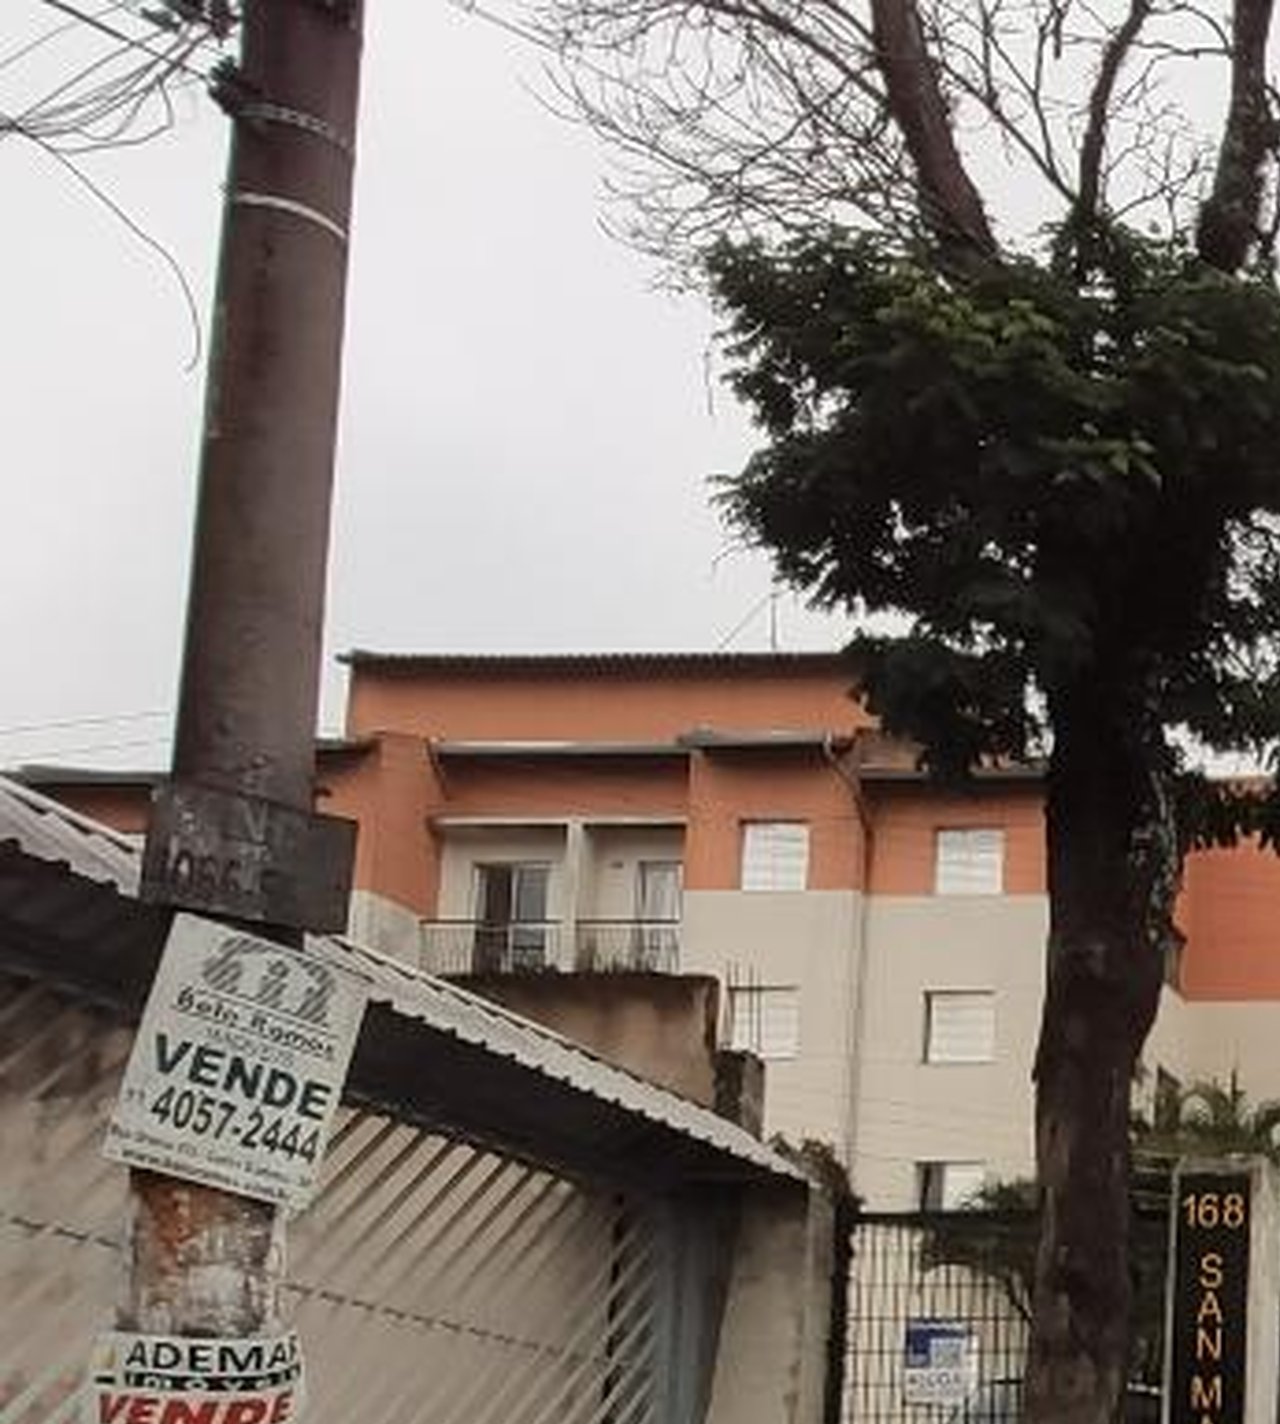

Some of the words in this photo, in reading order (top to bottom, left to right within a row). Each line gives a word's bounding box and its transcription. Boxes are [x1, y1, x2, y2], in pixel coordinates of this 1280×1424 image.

[154, 1033, 332, 1120] VENDE
[150, 1084, 323, 1165] 4057-2444
[1182, 1193, 1245, 1228] 168
[1197, 1253, 1224, 1359] SAN
